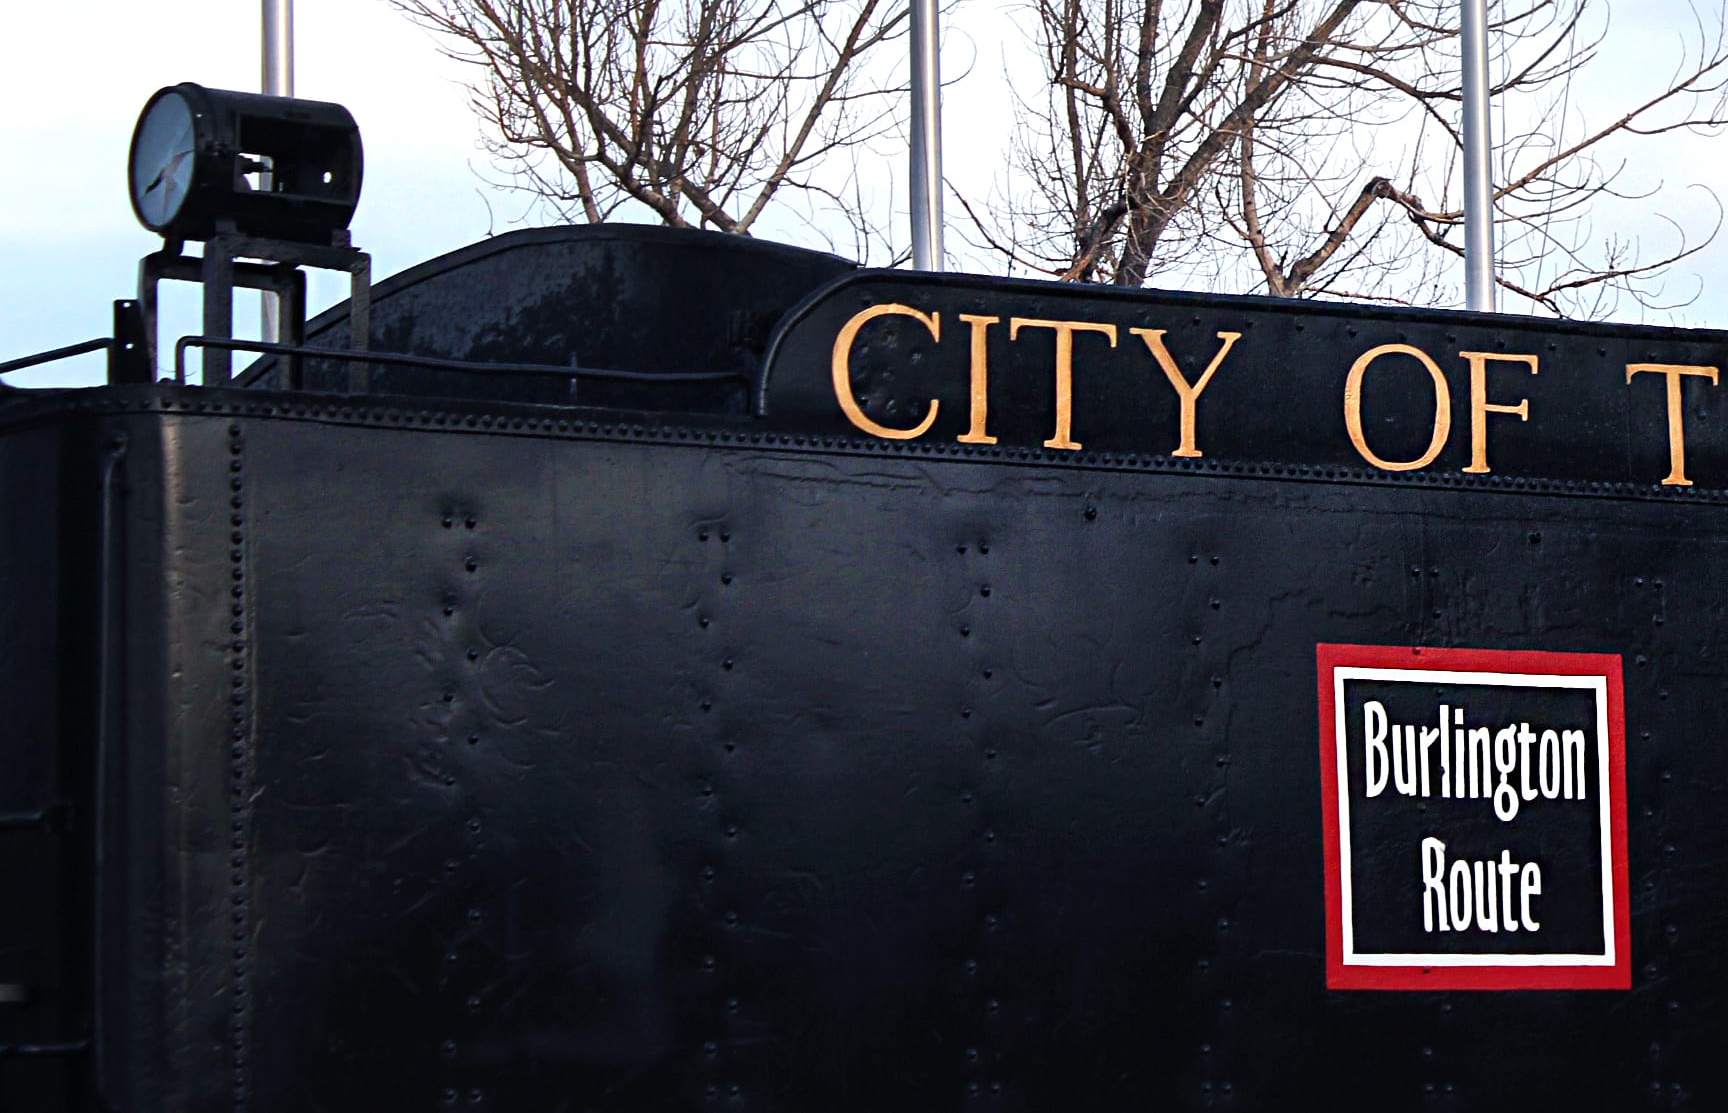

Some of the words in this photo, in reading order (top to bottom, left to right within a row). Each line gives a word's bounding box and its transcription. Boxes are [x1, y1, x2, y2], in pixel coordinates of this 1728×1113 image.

[832, 303, 1242, 458] CITY
[1344, 343, 1539, 474] OF
[1363, 700, 1586, 822] Burlington
[1421, 836, 1542, 933] Route
